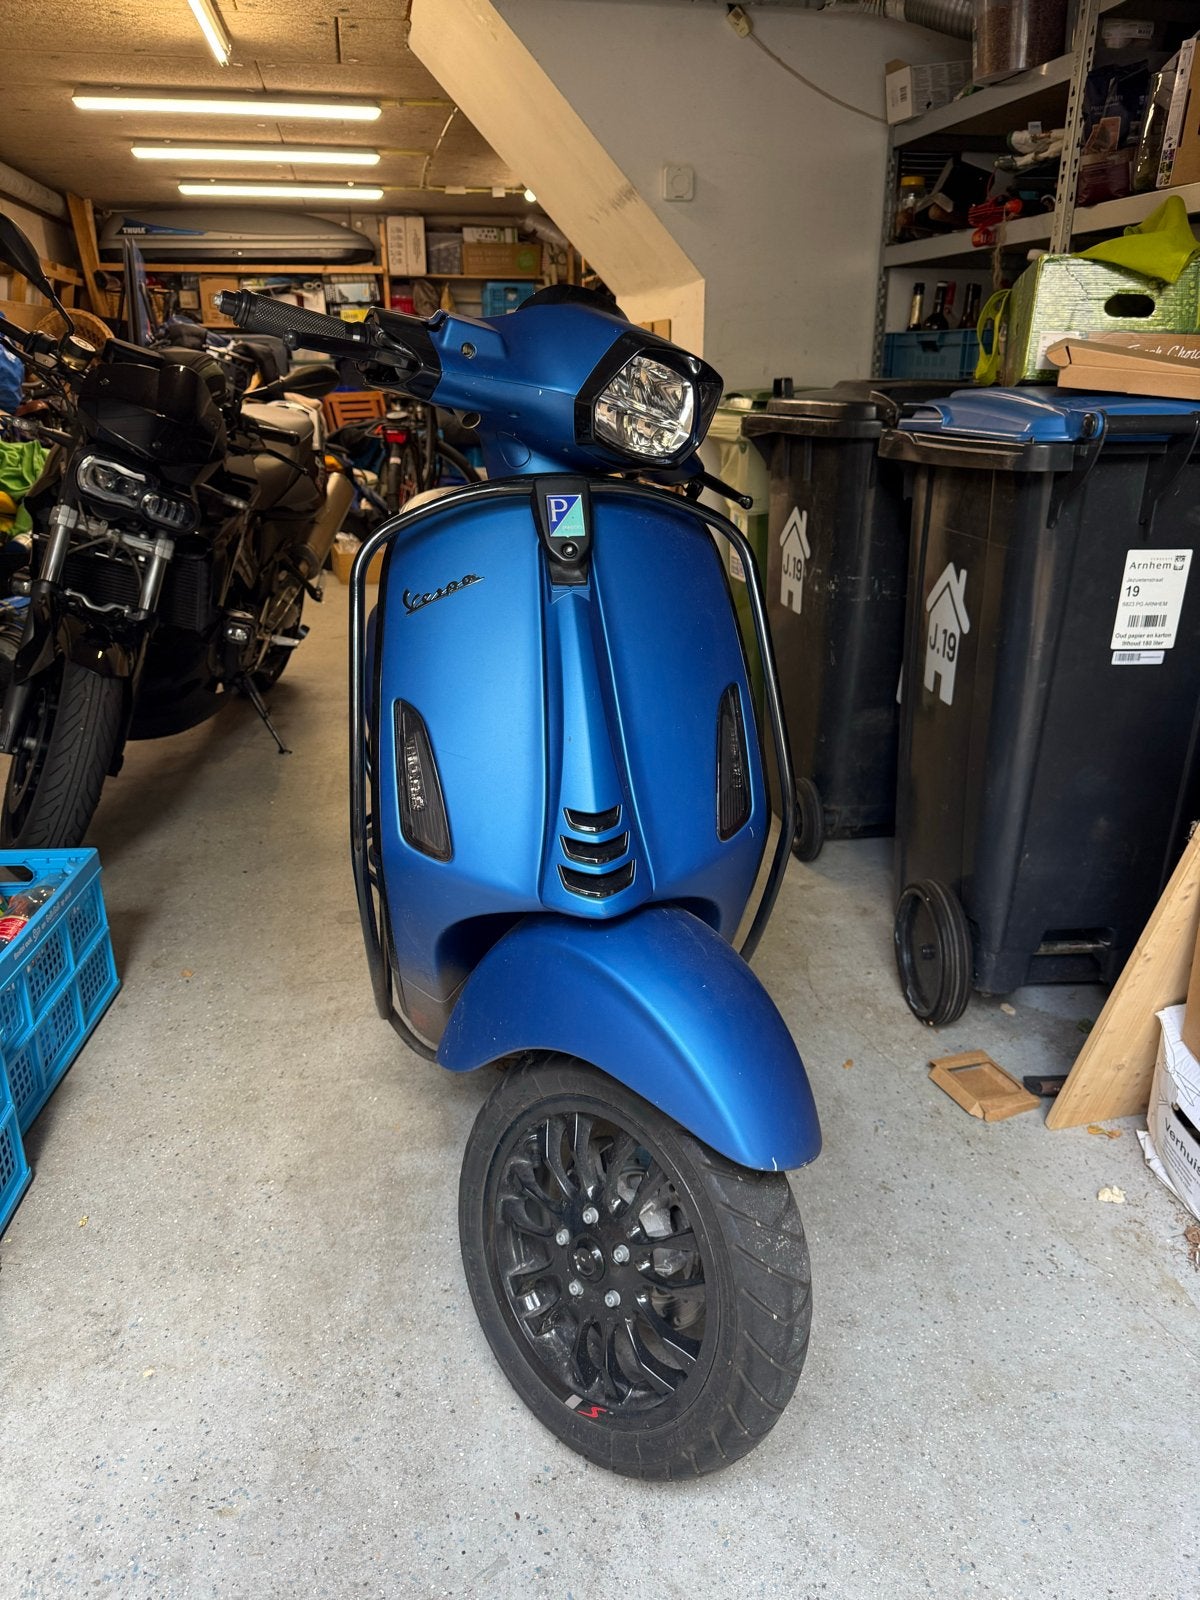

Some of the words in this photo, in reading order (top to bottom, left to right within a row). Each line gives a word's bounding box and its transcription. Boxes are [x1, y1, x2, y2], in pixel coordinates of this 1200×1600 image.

[550, 498, 568, 521] P
[783, 555, 802, 582] J.19
[1129, 561, 1172, 570] Arnhem
[402, 573, 485, 616] Vespa
[1126, 586, 1140, 597] 19
[929, 623, 957, 663] J.19
